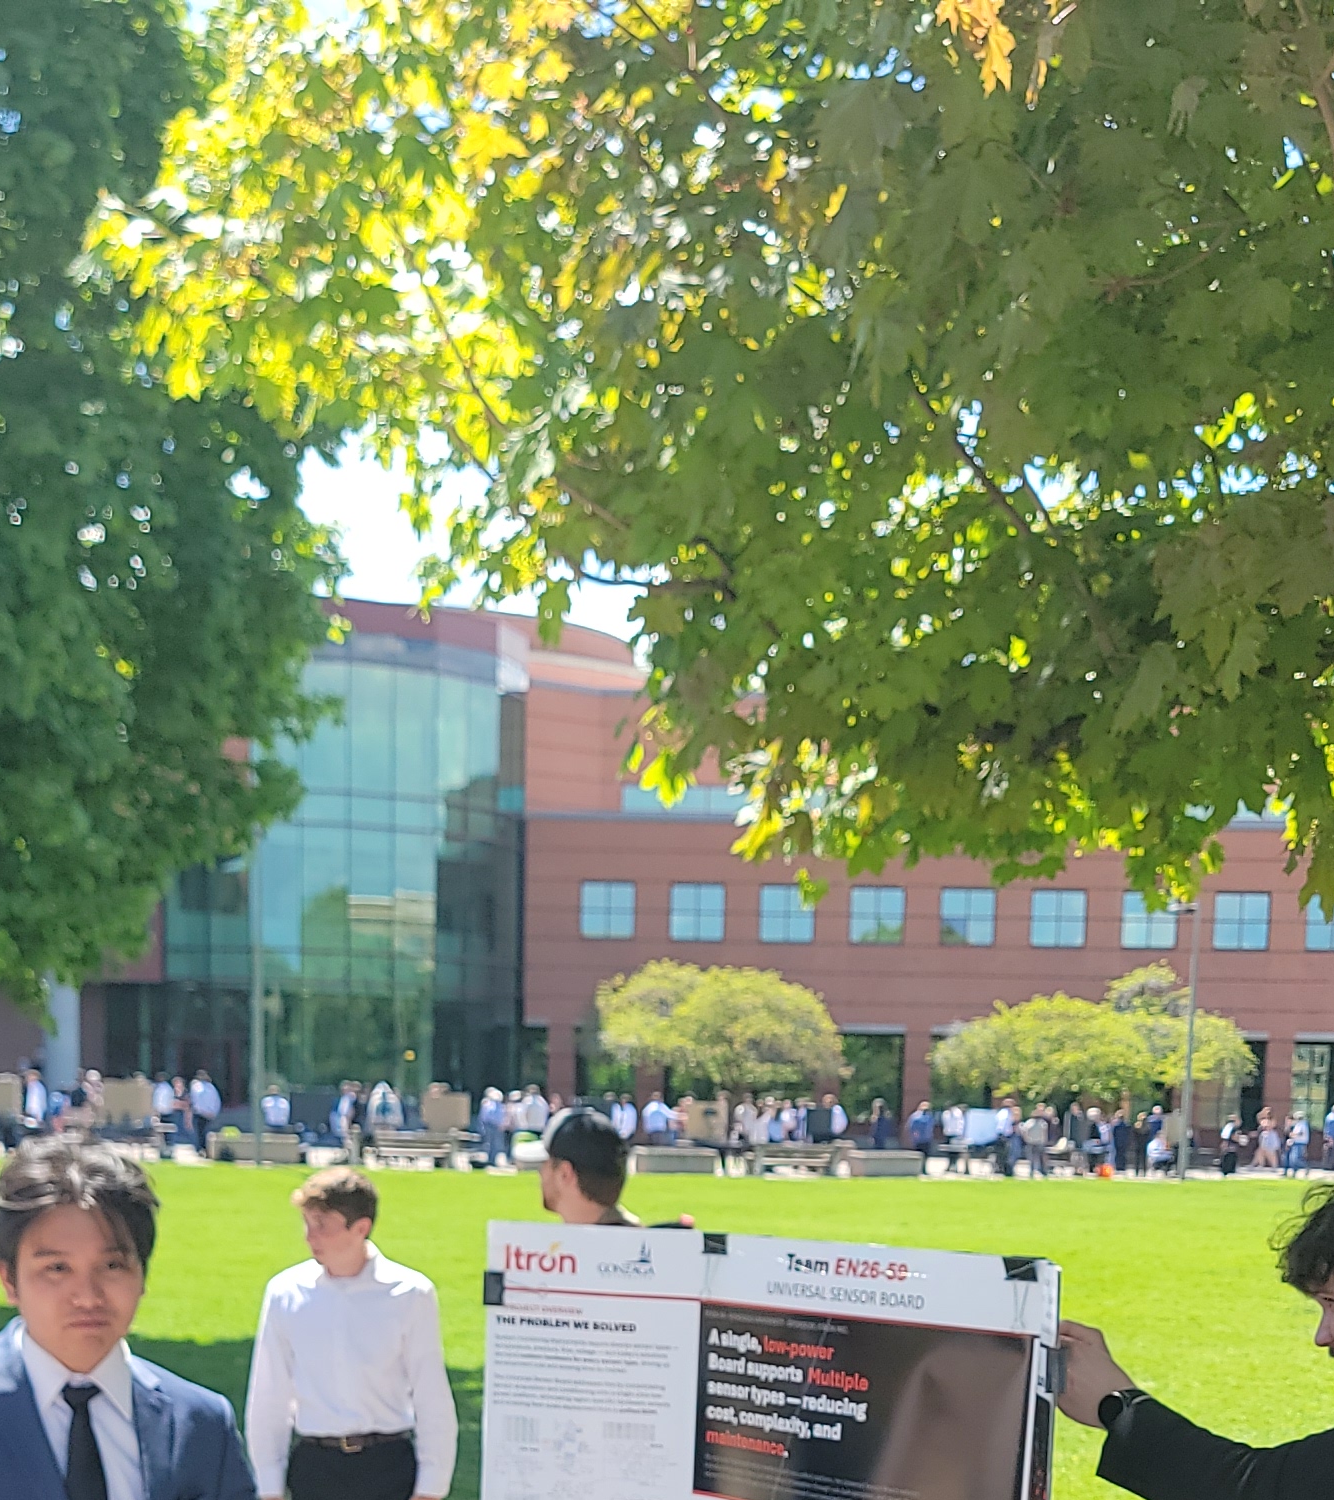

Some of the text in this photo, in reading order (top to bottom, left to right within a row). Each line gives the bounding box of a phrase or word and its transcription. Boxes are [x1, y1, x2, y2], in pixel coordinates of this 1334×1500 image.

[504, 1243, 577, 1274] Itron
[786, 1253, 829, 1275] Team
[767, 1281, 925, 1310] UNIVERSAL SENSOR BOARD
[495, 1314, 637, 1332] THE PROBLEM WE SOLVED
[707, 1327, 835, 1360] A single, low-power
[708, 1352, 869, 1392] Board supports Multiple
[706, 1380, 749, 1401] sensor
[750, 1384, 786, 1407] types
[801, 1393, 868, 1422] reducing
[705, 1404, 842, 1440] cost, complexity, and
[705, 1430, 789, 1458] maintenance.
